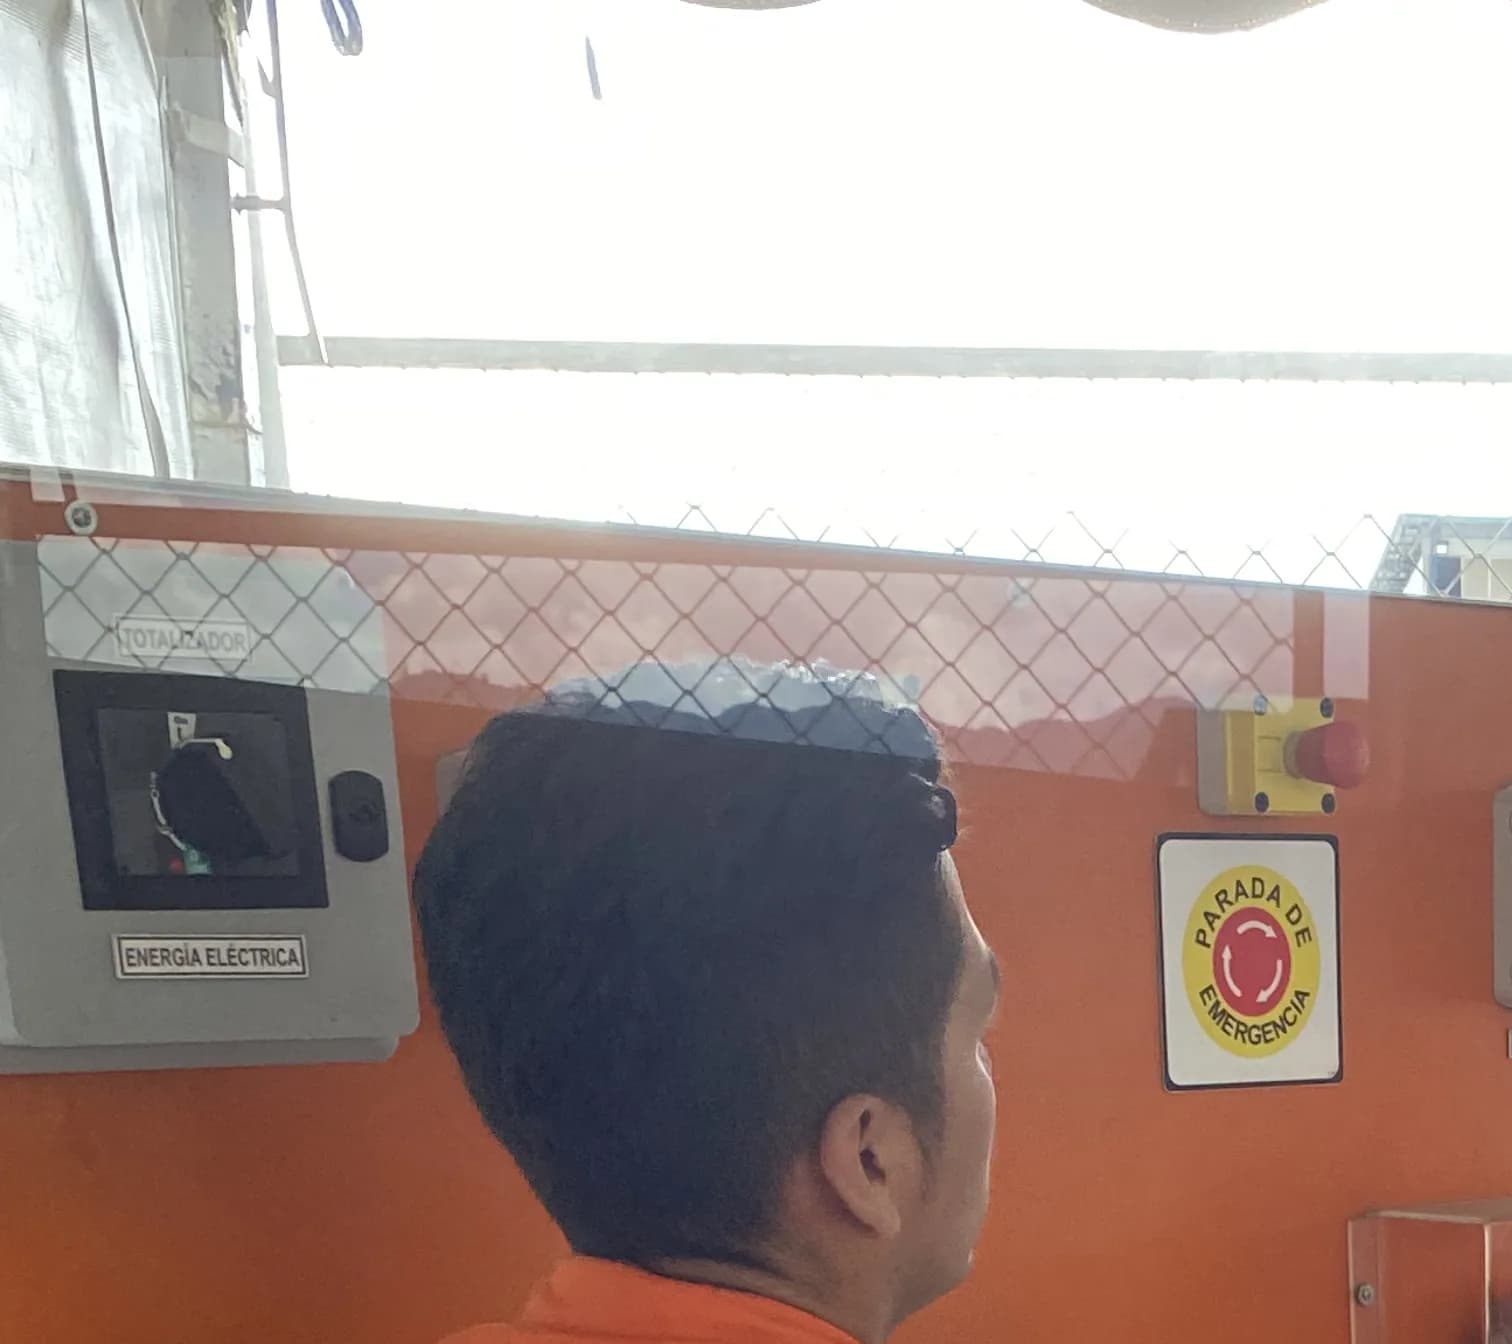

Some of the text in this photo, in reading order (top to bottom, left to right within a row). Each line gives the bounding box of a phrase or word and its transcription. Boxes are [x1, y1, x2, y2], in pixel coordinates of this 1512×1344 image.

[1195, 877, 1312, 949] PARADA DE
[125, 942, 301, 968] ENERGÍA ELÉCTRICA
[1199, 984, 1311, 1046] EMERGENCIA
